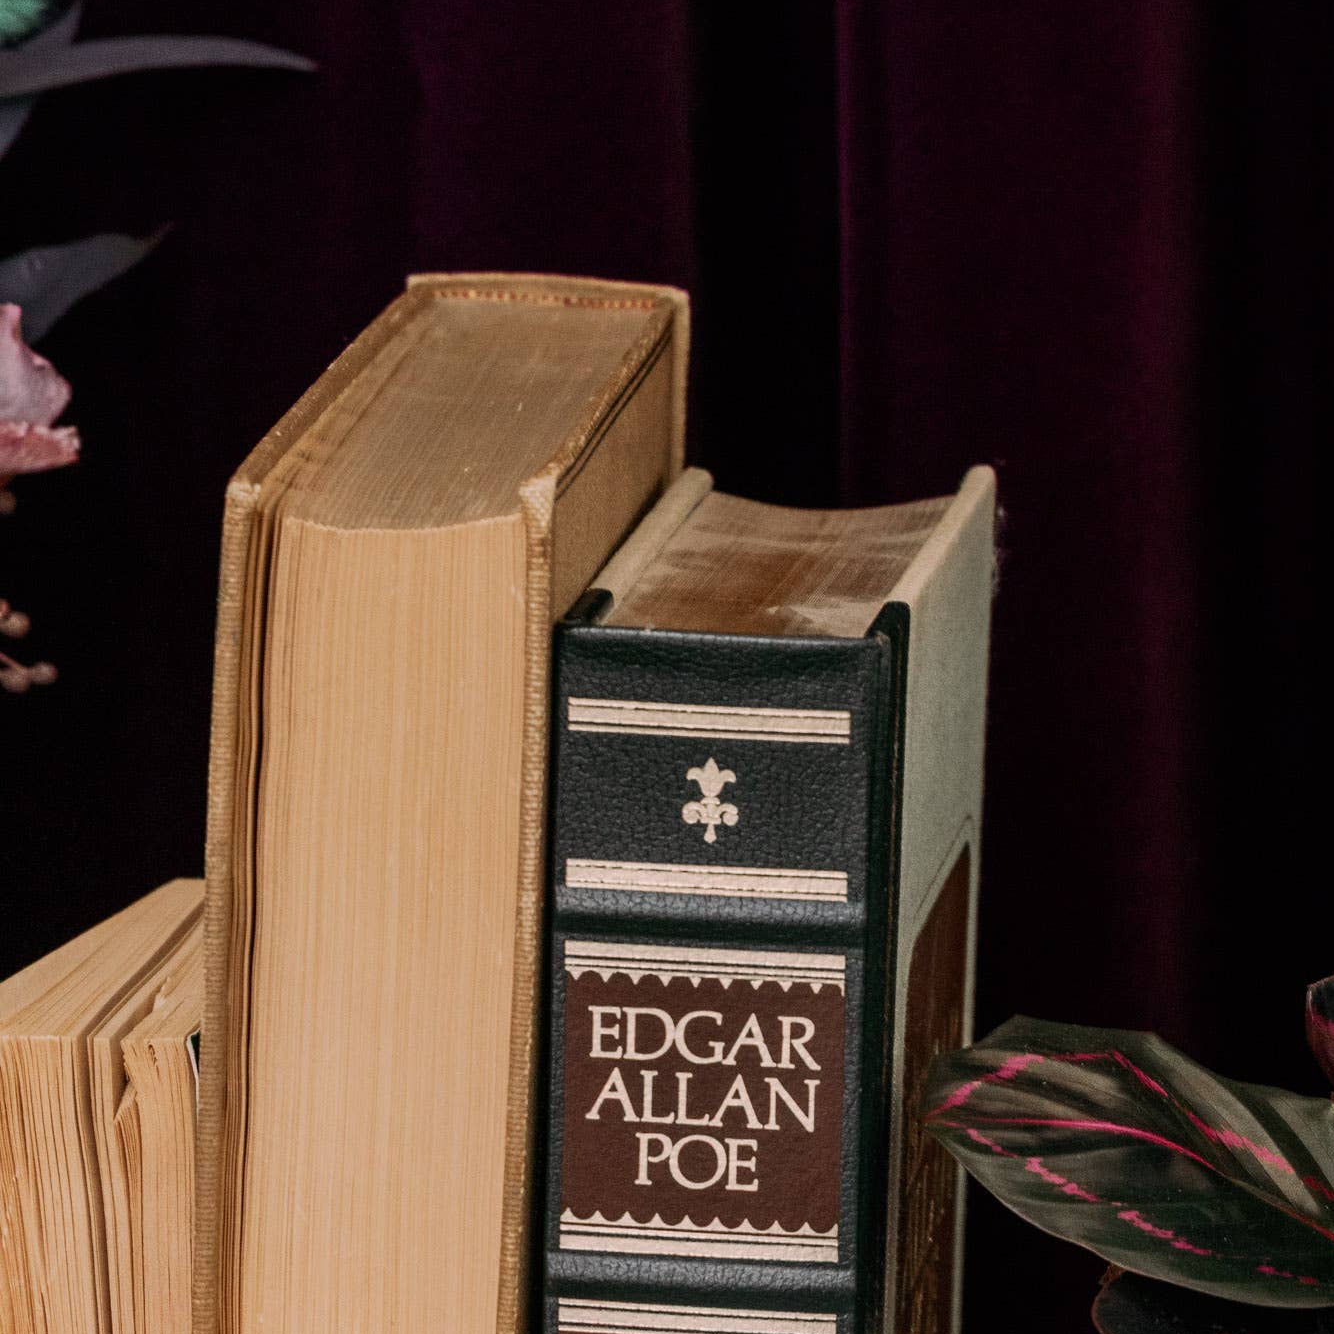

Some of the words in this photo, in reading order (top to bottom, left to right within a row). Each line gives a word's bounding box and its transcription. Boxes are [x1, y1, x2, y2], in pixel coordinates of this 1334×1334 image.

[588, 1005, 820, 1071] EDGAR
[585, 1067, 820, 1134] ALLAN
[634, 1131, 758, 1192] POE
